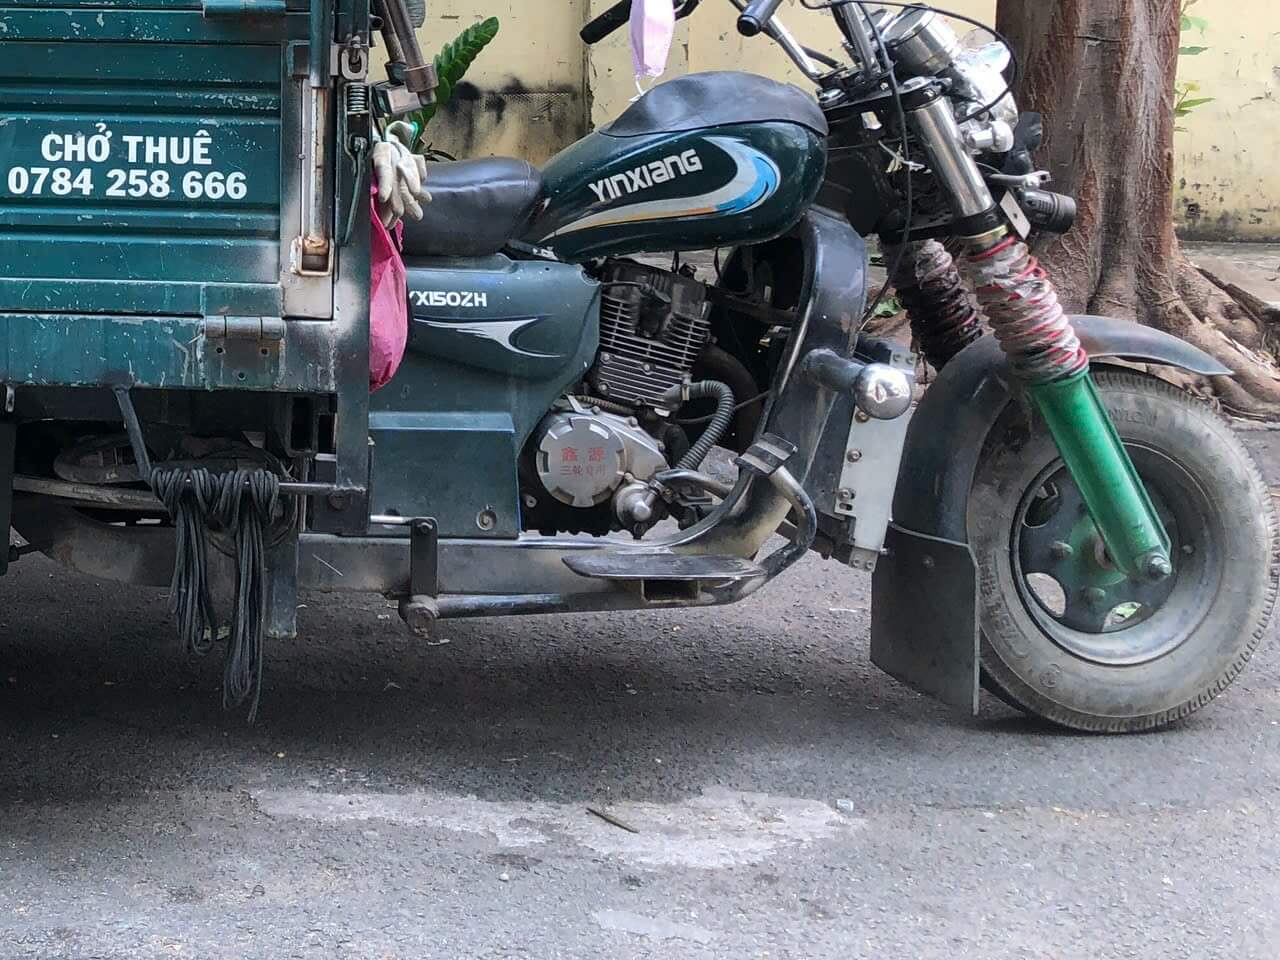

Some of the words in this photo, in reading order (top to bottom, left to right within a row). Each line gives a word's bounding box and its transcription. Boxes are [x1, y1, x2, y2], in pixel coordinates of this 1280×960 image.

[41, 122, 113, 163] CHỞ
[122, 129, 212, 165] THUÊ
[8, 166, 94, 195] 0784
[106, 169, 170, 198] 258
[182, 171, 247, 200] 666
[588, 148, 703, 203] YINXIANG
